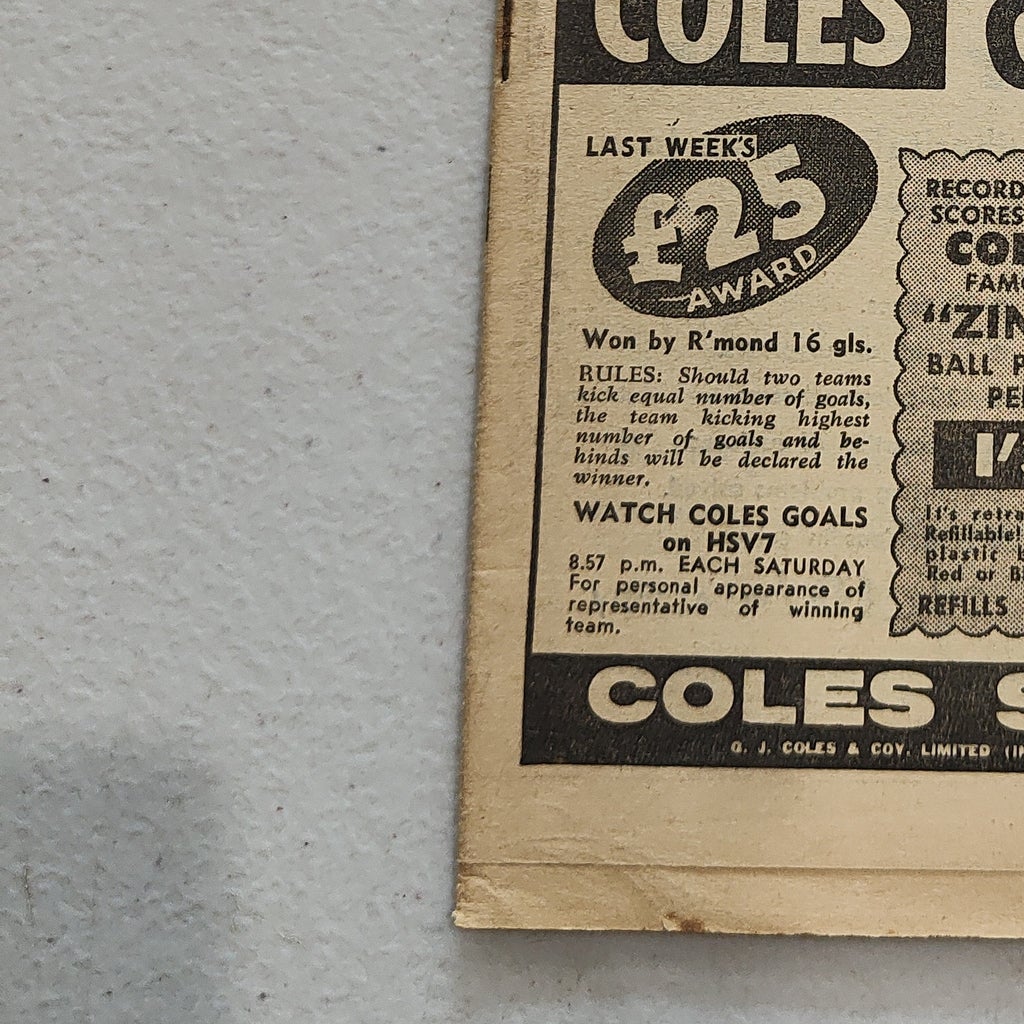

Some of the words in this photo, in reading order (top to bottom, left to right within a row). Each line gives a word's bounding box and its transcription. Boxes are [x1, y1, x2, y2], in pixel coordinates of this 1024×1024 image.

[586, 135, 651, 158] LAST
[665, 136, 757, 159] WEEK'S
[926, 178, 1024, 199] RECORD
[621, 143, 826, 284] £25
[930, 204, 1024, 225] SCORES
[687, 244, 818, 313] AWARD
[582, 328, 636, 350] Won
[649, 330, 676, 354] by
[688, 330, 778, 353] R'mond
[793, 331, 821, 353] 16
[833, 332, 873, 356] gls.
[579, 365, 662, 383] RULES:
[679, 367, 749, 384] Should
[764, 371, 800, 385] two
[816, 372, 872, 386] teams
[927, 353, 993, 376] BALL
[577, 385, 619, 402] kick
[630, 388, 684, 407] equal
[696, 389, 774, 406] number
[785, 389, 805, 409] of
[815, 390, 870, 410] goals,
[576, 407, 607, 423] the
[630, 409, 679, 424] team
[701, 409, 776, 429] kicking
[798, 410, 870, 430] highest
[576, 428, 653, 445] number
[673, 429, 695, 449] of
[714, 430, 763, 449] goals
[782, 432, 820, 448] and
[840, 432, 869, 449] be-
[574, 448, 629, 465] hinds
[645, 449, 685, 466] will
[700, 450, 723, 467] be
[738, 452, 822, 469] declared
[837, 452, 869, 470] the
[573, 469, 650, 487] winner.
[573, 501, 676, 524] WATCH
[688, 504, 769, 526] COLES
[782, 505, 868, 528] GOALS
[926, 505, 957, 521] It's
[663, 536, 691, 552] on
[707, 531, 776, 554] HSV7
[925, 524, 1021, 542] Refillable!
[926, 545, 998, 563] plastic
[569, 554, 606, 570] 8.57
[620, 557, 664, 576] p.m.
[679, 556, 740, 573] EACH
[754, 558, 866, 577] SATURDAY
[928, 565, 962, 582] Red
[976, 568, 996, 582] or
[569, 574, 600, 592] For
[616, 577, 699, 596] personal
[714, 579, 830, 599] appearance
[845, 581, 866, 598] of
[569, 597, 709, 616] representative
[739, 600, 759, 617] of
[790, 601, 864, 622] winning
[918, 594, 1008, 616] REFILLS
[565, 619, 621, 635] team.
[588, 665, 936, 728] COLES
[758, 741, 771, 754] J.
[782, 741, 837, 754] COLES
[848, 742, 859, 755] &
[871, 742, 911, 756] COY.
[921, 743, 991, 757] LIMITED
